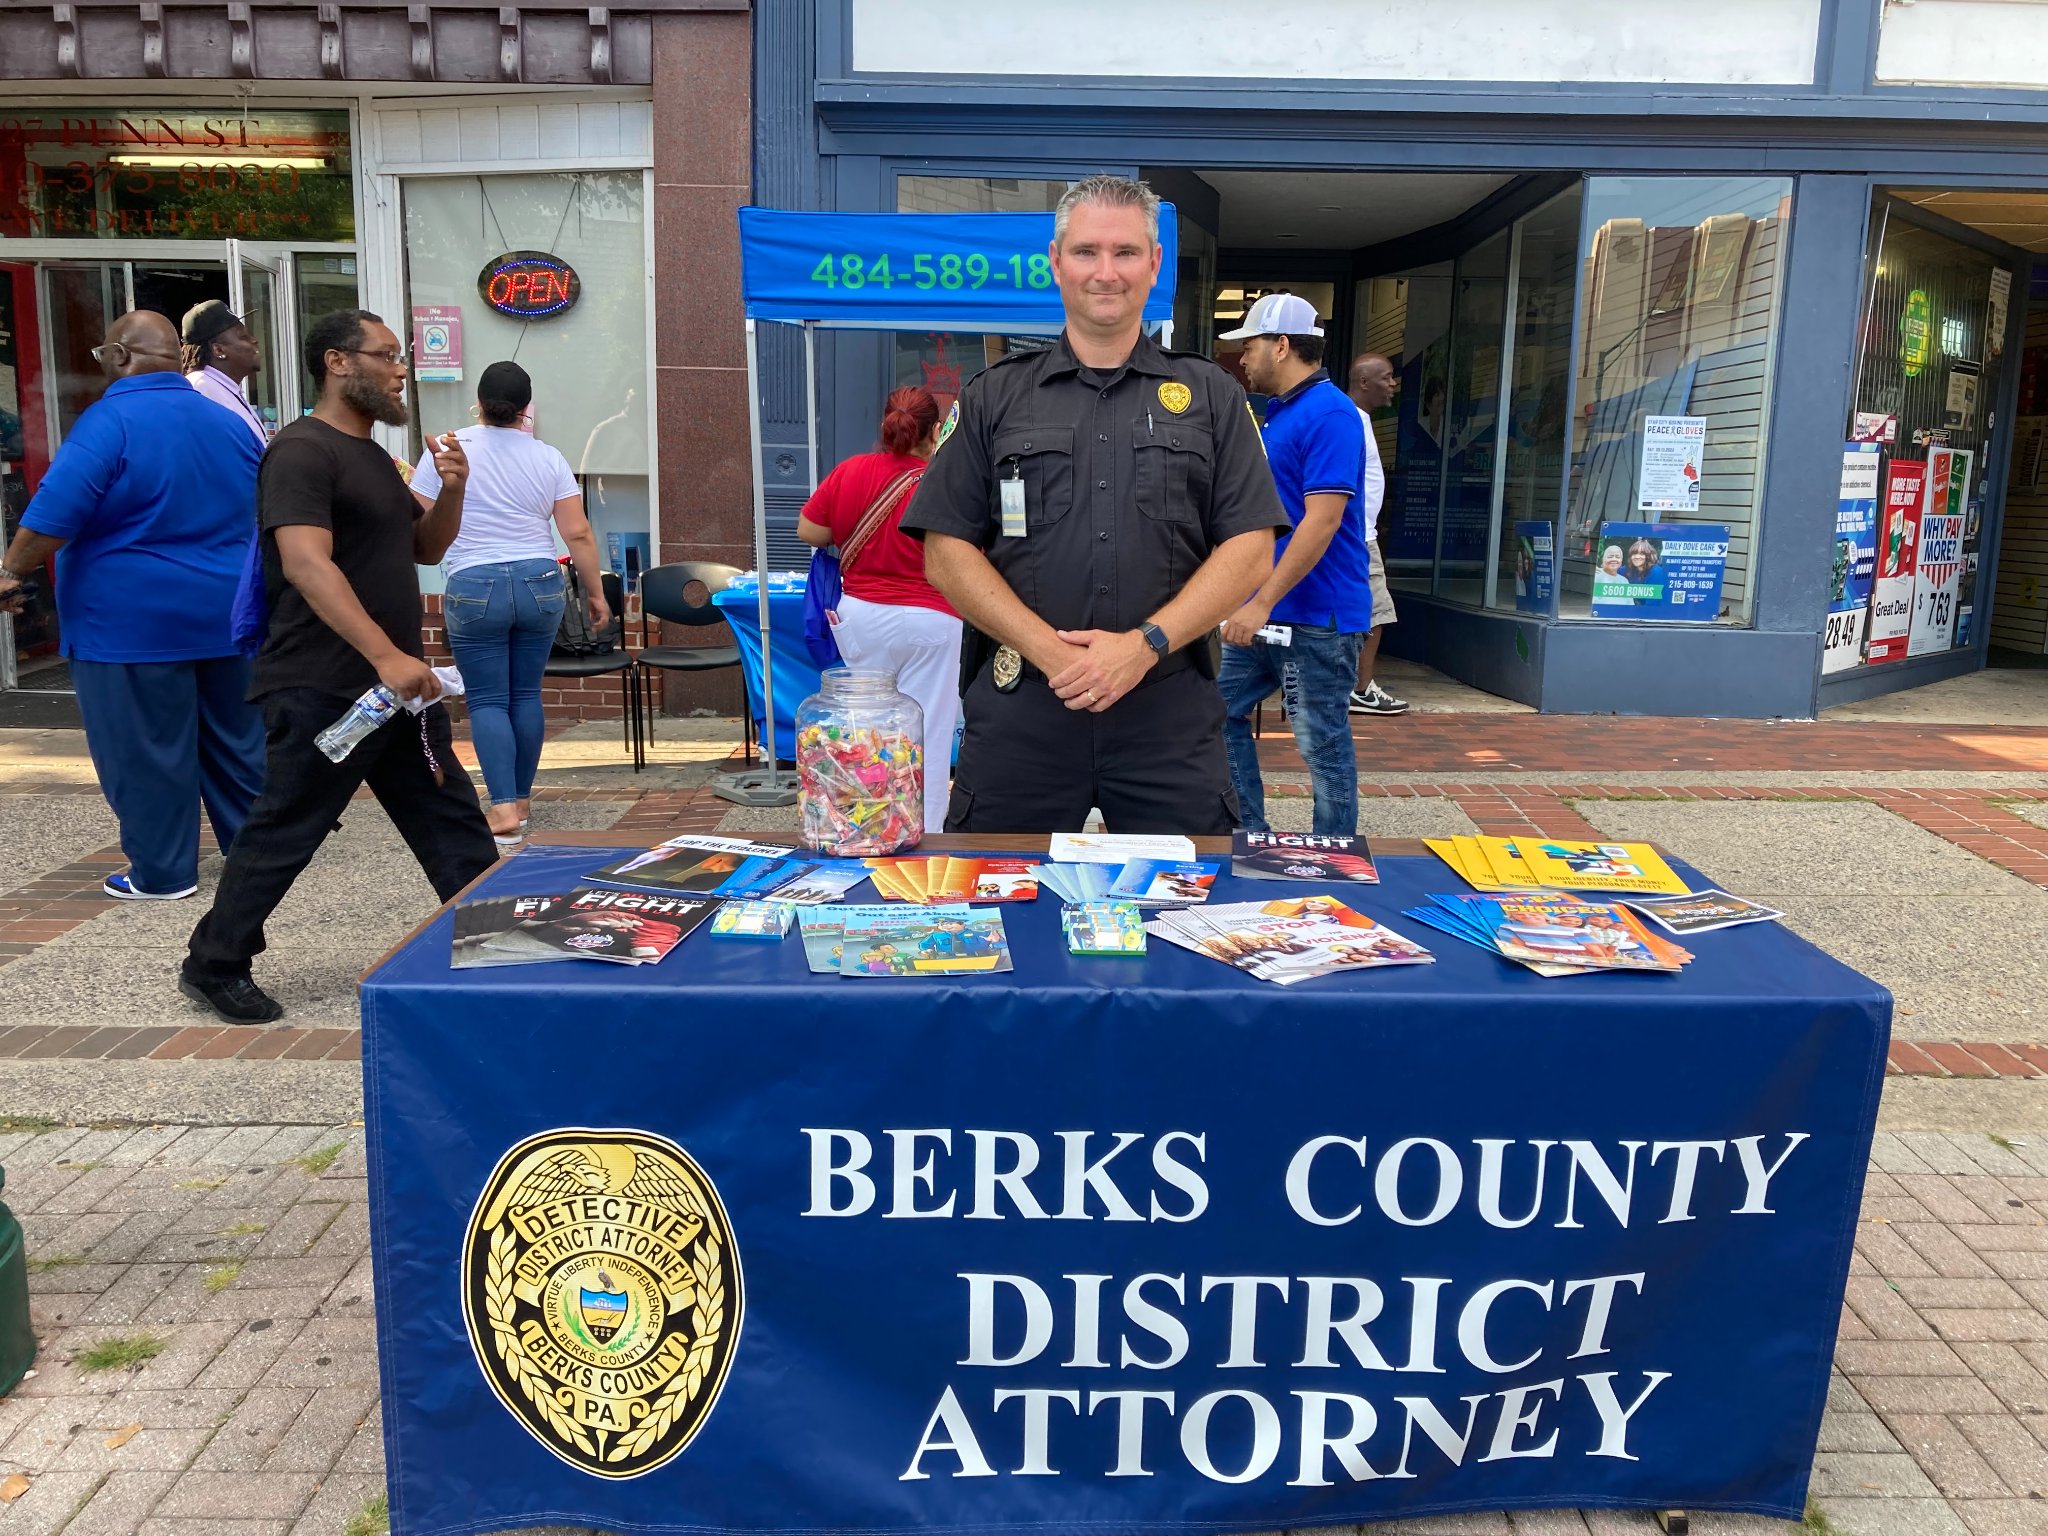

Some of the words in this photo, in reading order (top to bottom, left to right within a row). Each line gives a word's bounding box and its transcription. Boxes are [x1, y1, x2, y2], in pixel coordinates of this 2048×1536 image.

[59, 118, 186, 147] PENN
[203, 118, 270, 149] ST.
[2, 161, 299, 196] 0-375-8030
[810, 252, 1053, 290] 484-589-18
[488, 270, 570, 304] OPEN
[1647, 425, 1670, 434] PEACE
[1676, 426, 1703, 435] GLOVES
[1891, 477, 1906, 492] MORE
[1906, 478, 1921, 492] TASTE
[1924, 517, 1946, 540] WHY
[1946, 517, 1962, 539] PAY
[1664, 542, 1682, 550] DAILY
[1683, 542, 1699, 551] DOVE
[1700, 543, 1716, 552] CARE
[1923, 540, 1957, 563] MORE?
[1602, 585, 1625, 596] $600
[1626, 586, 1655, 597] BONUS
[1668, 580, 1713, 590] 215-809-1639
[1875, 602, 1893, 617] Great
[1894, 597, 1909, 615] Deal
[672, 838, 703, 847] STOP
[1247, 834, 1354, 848] FIGHT
[574, 894, 705, 915] FIGHT
[648, 895, 687, 904] WORK
[1501, 904, 1610, 914] CHOICES
[1257, 919, 1318, 932] STOP
[1300, 931, 1391, 946] VIOLENCE
[800, 1127, 1210, 1224] BERKS
[1284, 1130, 1811, 1230] COUNTY
[523, 1197, 689, 1244] DETECTIVE
[517, 1226, 595, 1280] DISTRICT
[600, 1226, 694, 1287] ATTORNEY
[547, 1280, 563, 1322] VIRTUE
[562, 1256, 605, 1283] LIBERTY
[607, 1257, 661, 1329] INDEPENDENCE
[955, 1271, 1646, 1375] DISTRICT
[557, 1332, 597, 1363] BERKS
[600, 1340, 648, 1366] COUNTY
[526, 1333, 594, 1389] BERKS
[600, 1340, 682, 1395] COUNTY
[584, 1401, 623, 1427] PA.
[898, 1371, 1673, 1488] ATTORNEY
